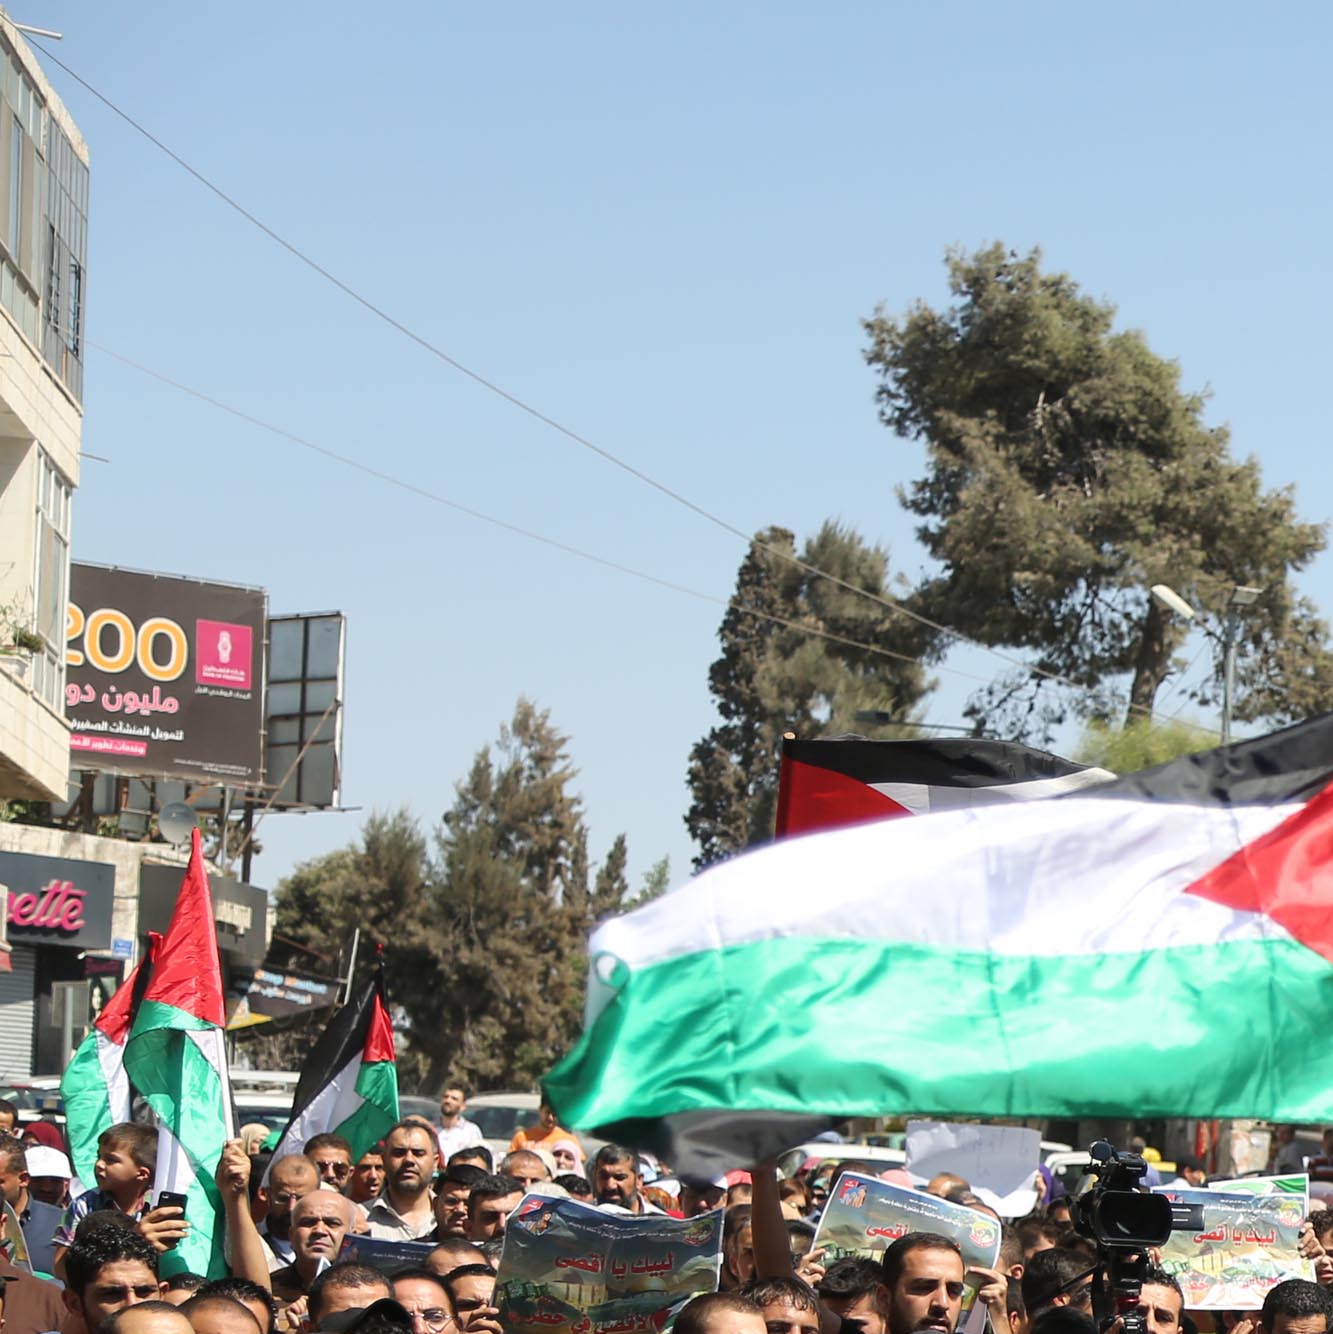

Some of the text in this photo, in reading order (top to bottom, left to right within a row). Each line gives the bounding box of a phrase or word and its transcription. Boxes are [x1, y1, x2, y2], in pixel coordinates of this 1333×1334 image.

[65, 683, 179, 716] مليون دو
[554, 1252, 673, 1279] لبيك يا أقصى
